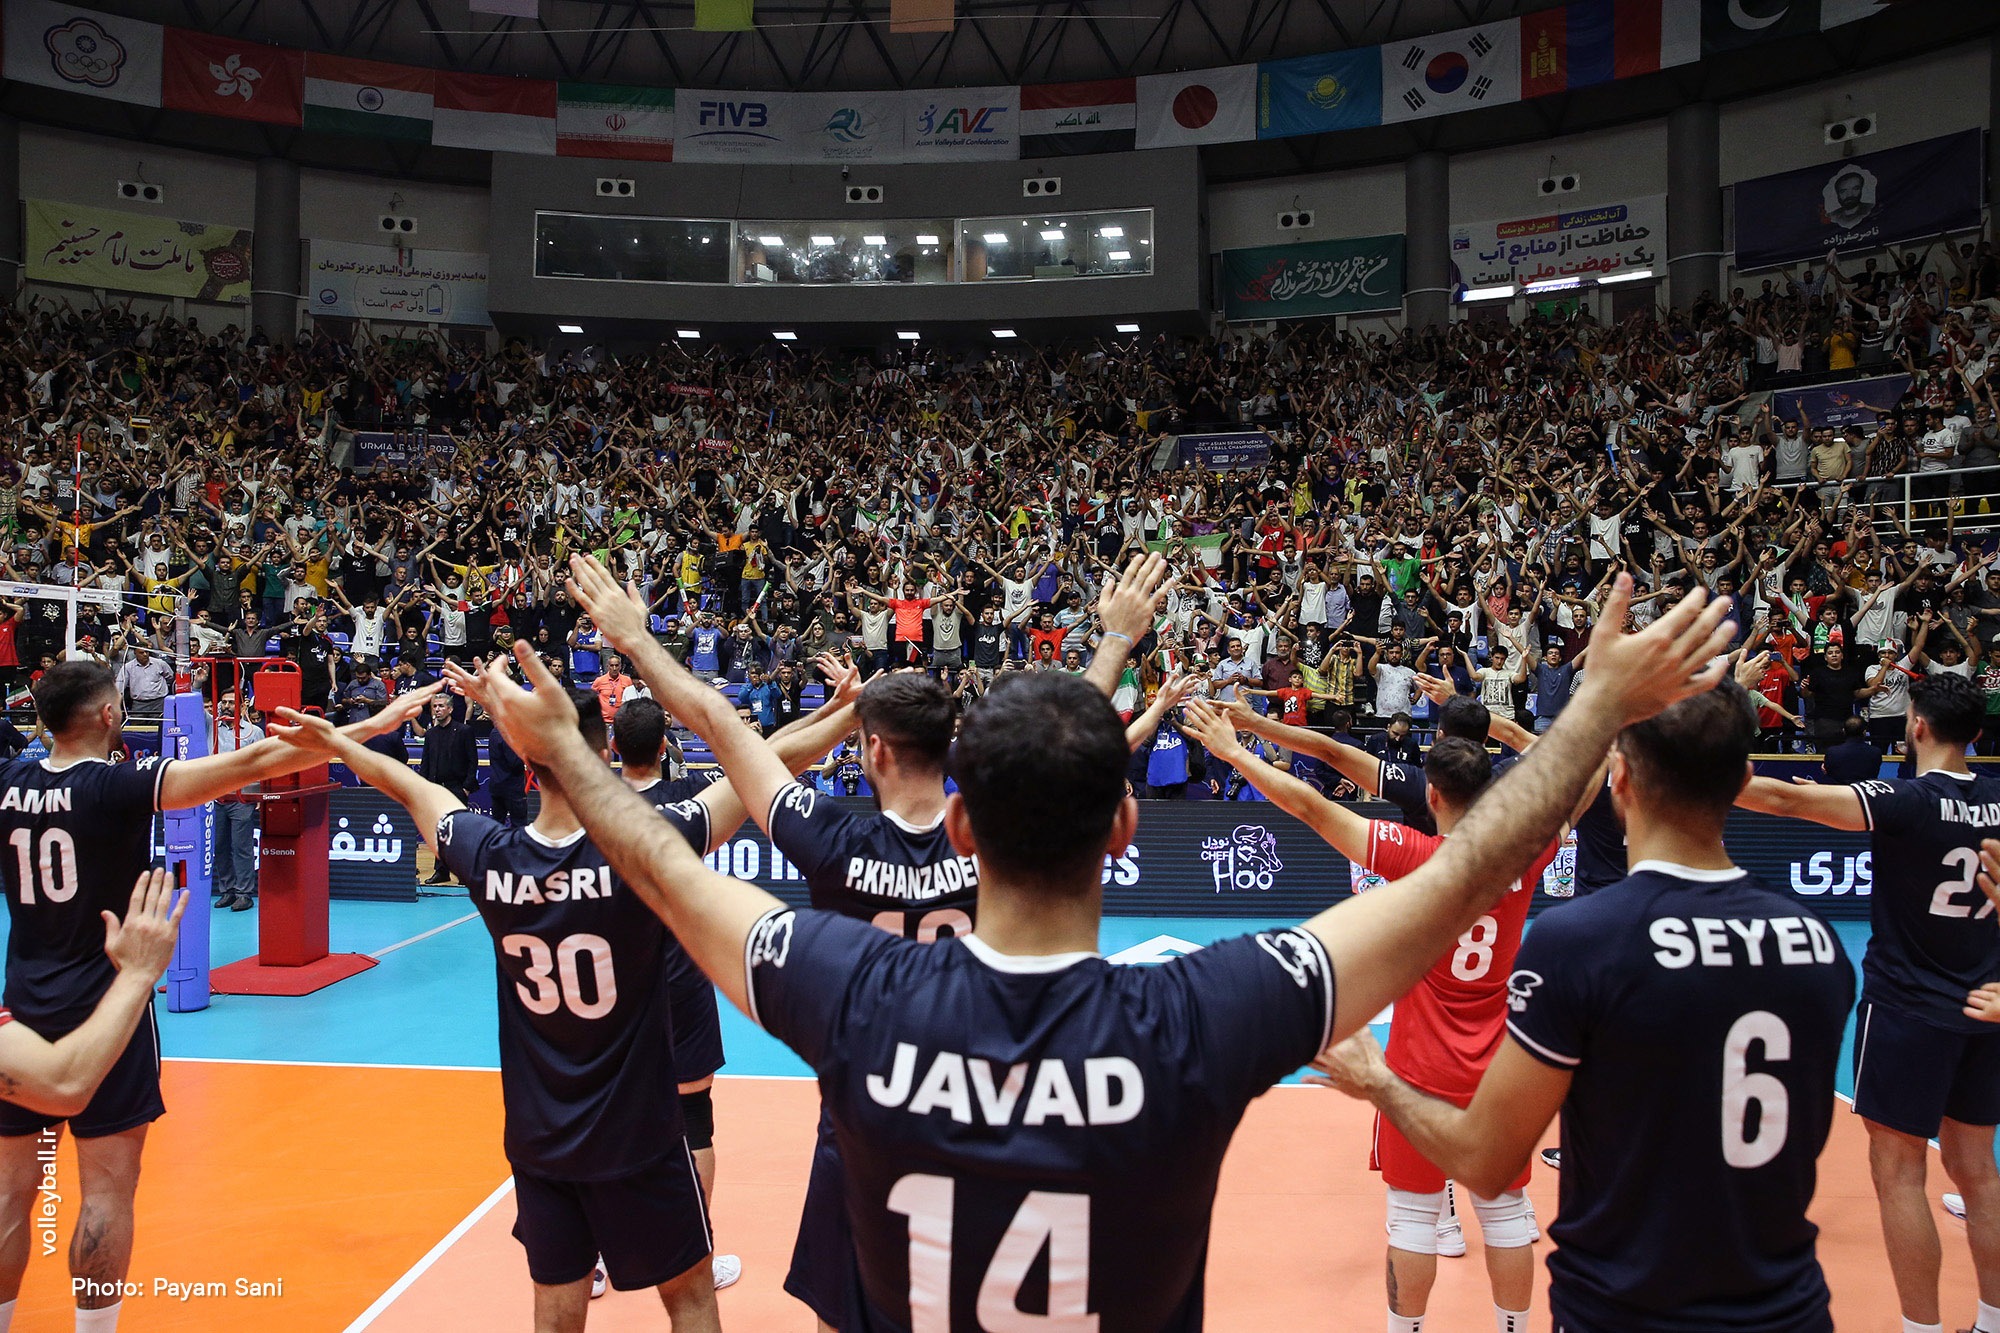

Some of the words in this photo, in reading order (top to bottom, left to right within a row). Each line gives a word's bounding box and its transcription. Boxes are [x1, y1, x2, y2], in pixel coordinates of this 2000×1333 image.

[699, 101, 768, 127] FIVB
[935, 107, 1008, 134] AVC
[934, 138, 964, 147] Volleyball
[965, 137, 1010, 146] Confederation
[1558, 234, 1572, 257] از
[1575, 223, 1650, 248] حفاظت
[1858, 226, 1879, 241] ناصر
[1479, 240, 1505, 265] آب
[1508, 238, 1557, 265] منابع
[1560, 252, 1621, 274] نهضت
[1624, 245, 1655, 268] یک
[376, 264, 403, 277] والیبال
[403, 266, 420, 277] ملی
[1473, 267, 1516, 285] است
[1518, 263, 1556, 286] ملی
[379, 286, 408, 297] هست
[411, 289, 424, 298] آب
[390, 300, 405, 311] کم
[406, 301, 424, 312] ولی
[0, 786, 72, 814] AMIN
[1940, 798, 2000, 828] M.VAZAD
[204, 814, 214, 876] Senoh
[270, 848, 295, 856] Senoh
[1202, 836, 1230, 849] نودل
[9, 827, 78, 904] 10
[1200, 850, 1230, 861] CHEF
[486, 866, 613, 905] NASRI
[1450, 914, 1498, 981] 8
[1649, 917, 1836, 969] SEYED
[502, 933, 617, 1019] 30
[866, 1041, 1145, 1126] JAVAD
[1721, 1010, 1791, 1168] 6
[886, 1173, 1100, 1333] 14
